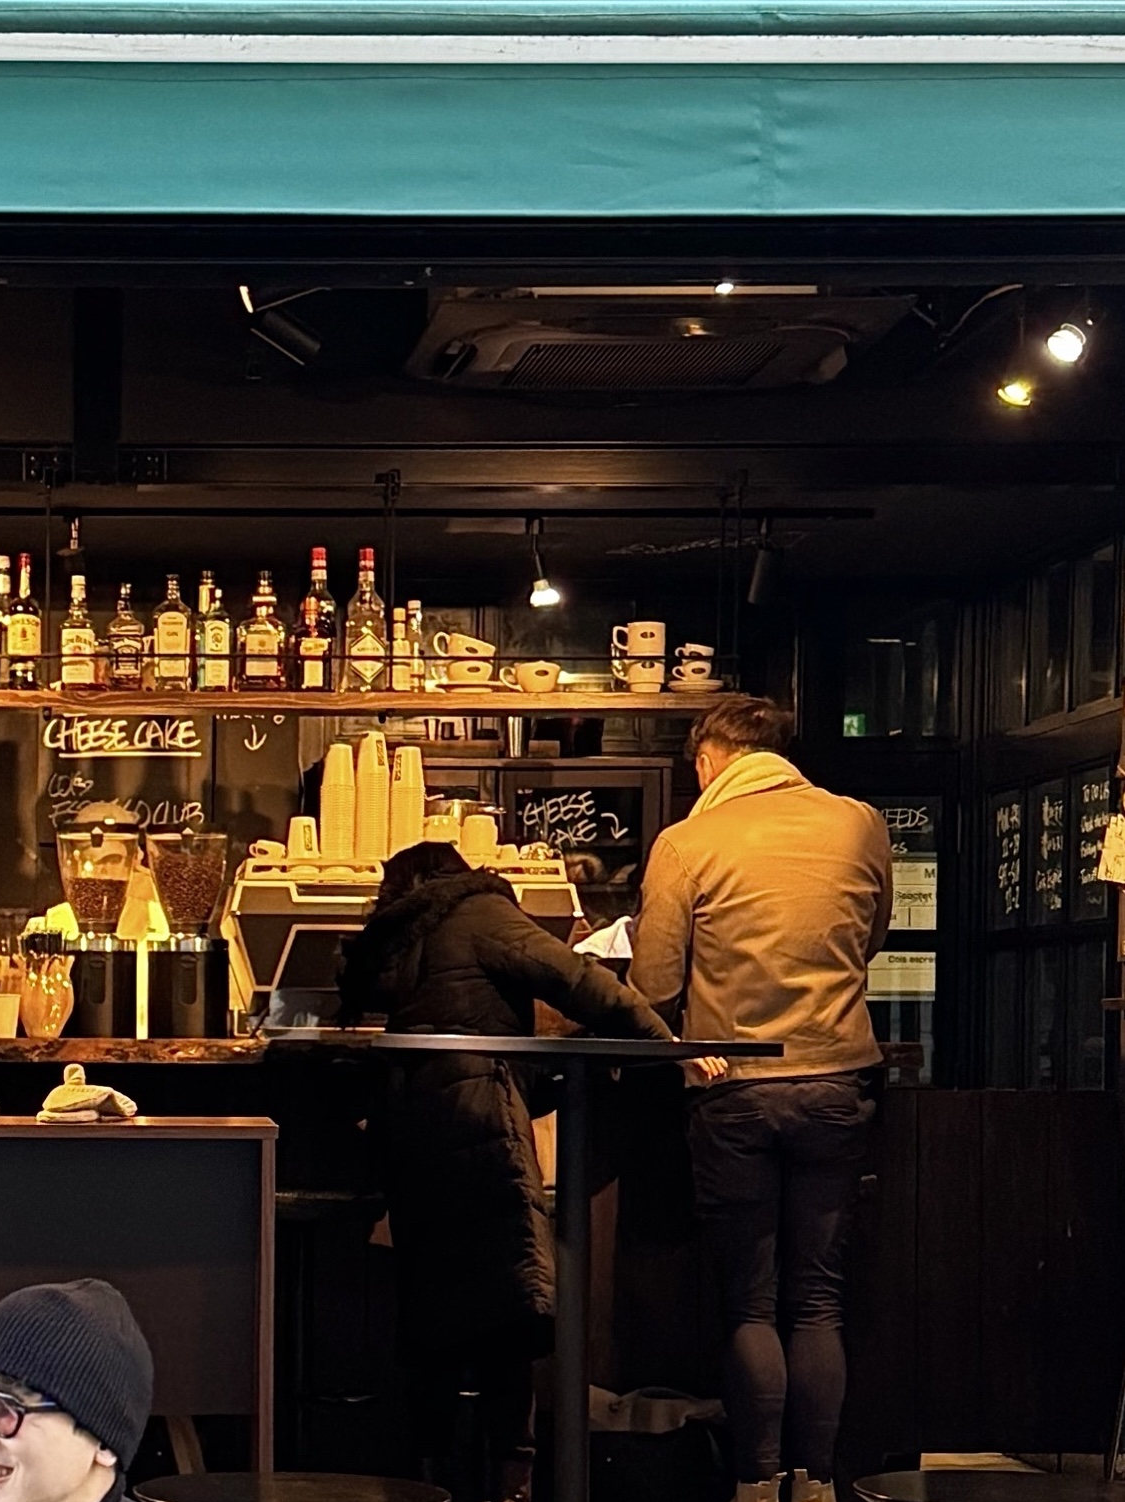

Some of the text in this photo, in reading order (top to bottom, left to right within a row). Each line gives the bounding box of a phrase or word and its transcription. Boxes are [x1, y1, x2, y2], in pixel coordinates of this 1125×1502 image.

[43, 717, 201, 751] CHEESE CAKE
[523, 791, 596, 826] CHEESE
[881, 806, 929, 829] EEDS
[548, 819, 597, 850] CAKE
